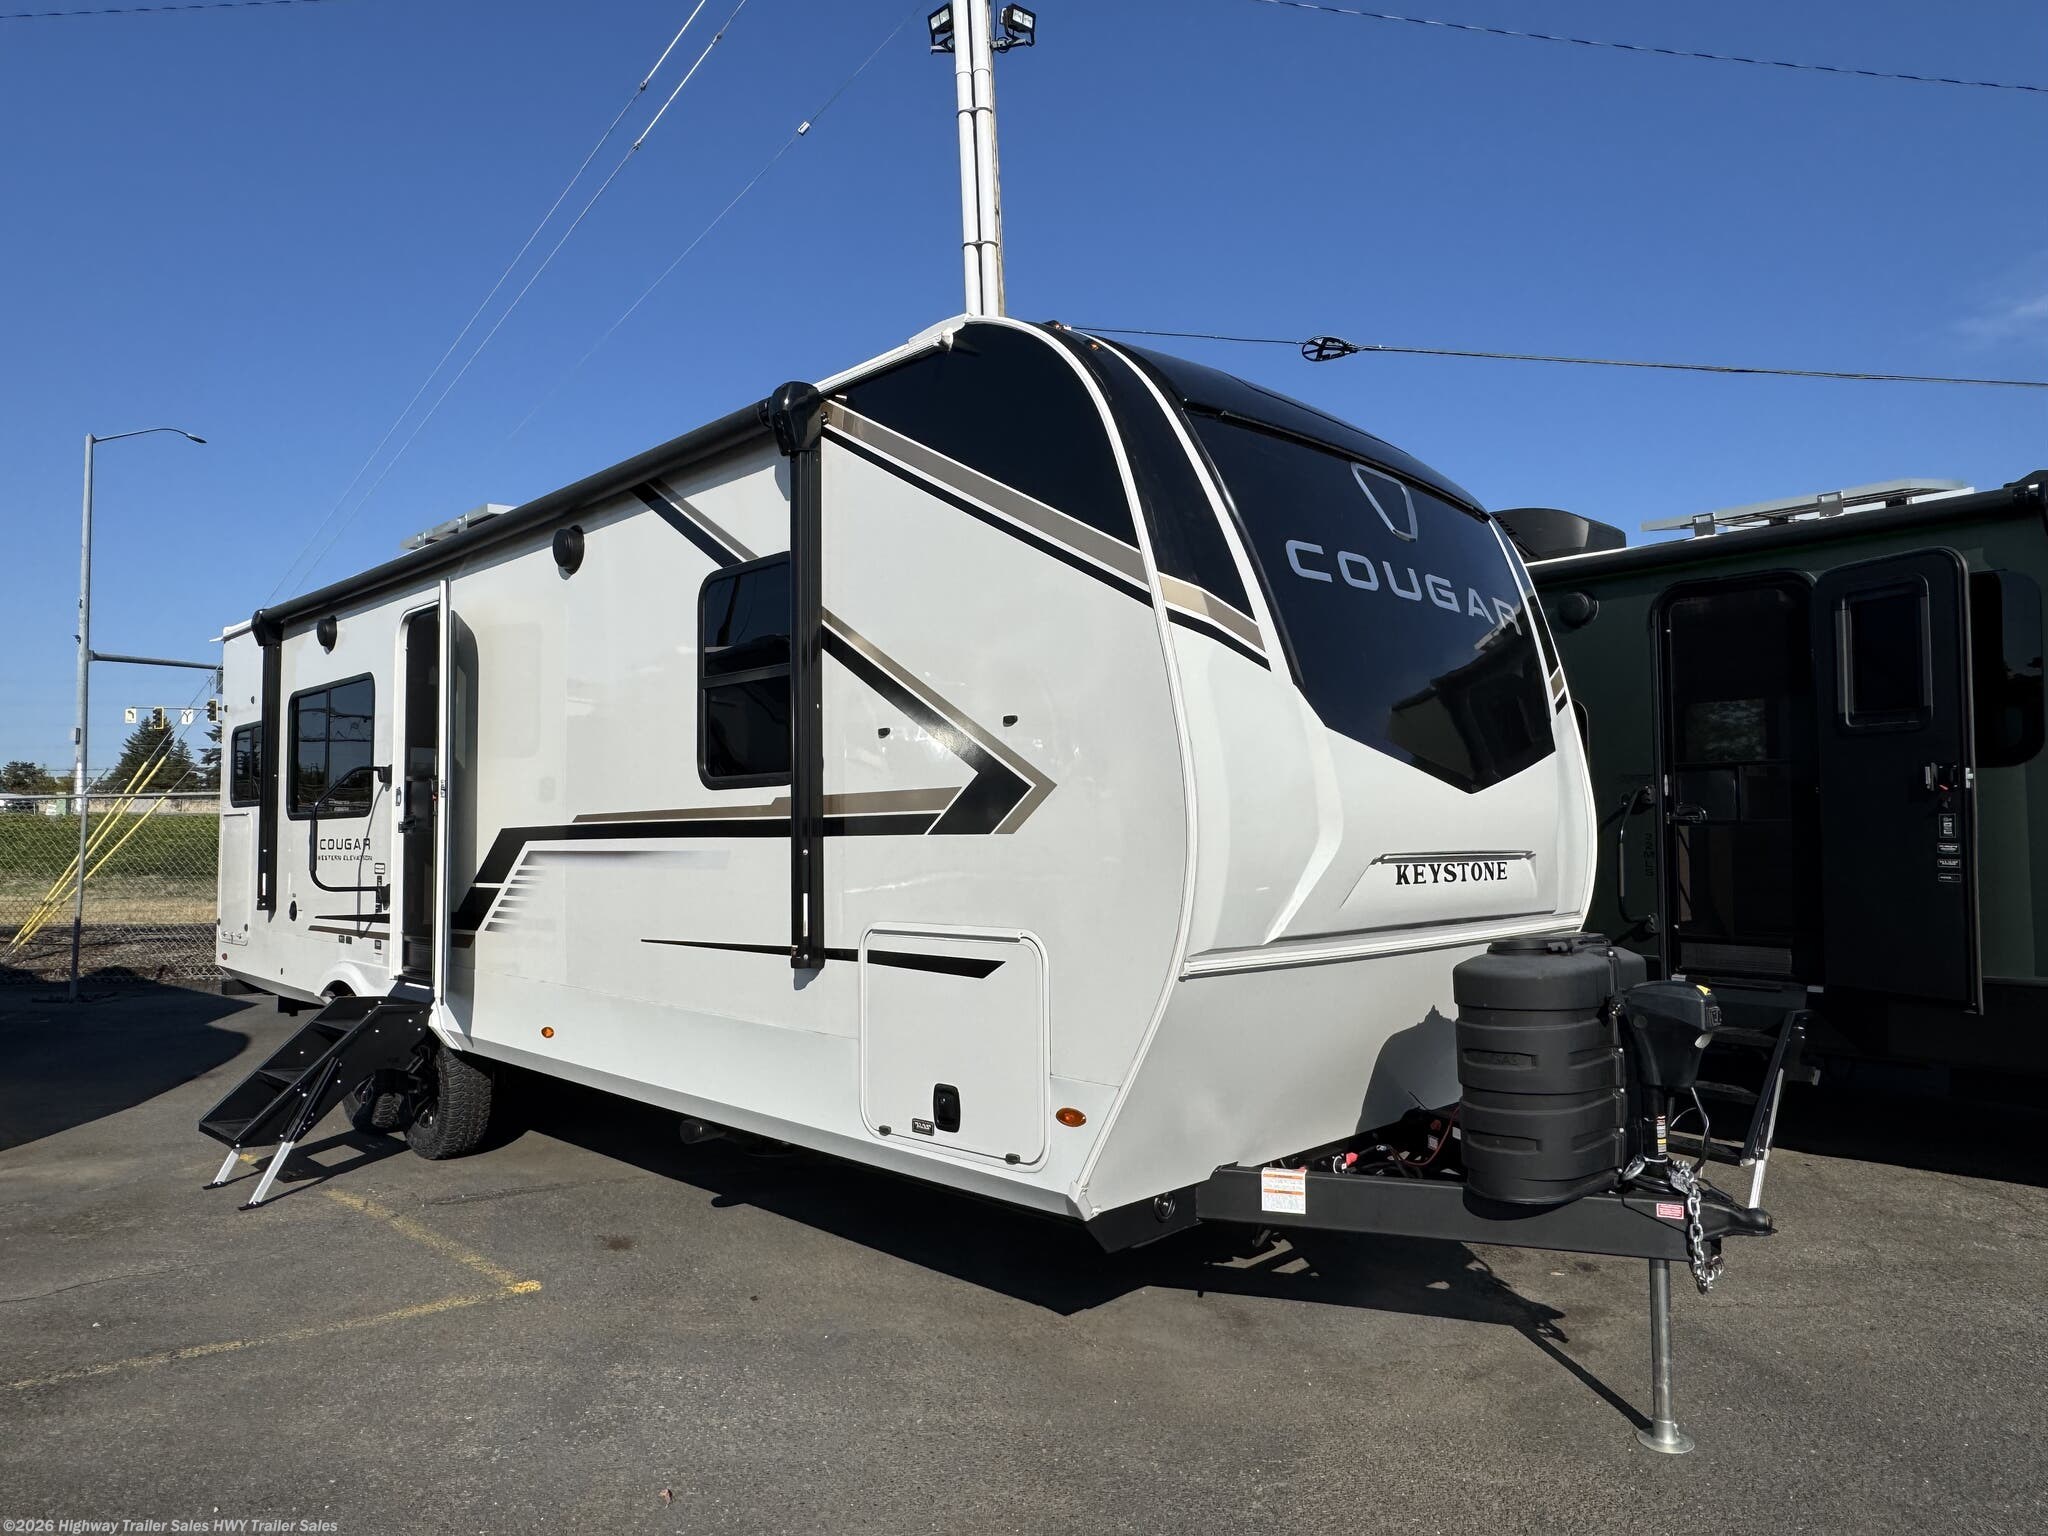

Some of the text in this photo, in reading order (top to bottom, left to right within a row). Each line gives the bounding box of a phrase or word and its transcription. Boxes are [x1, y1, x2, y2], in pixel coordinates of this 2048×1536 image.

[1285, 539, 1522, 636] COUGAR
[320, 838, 371, 850] COUGAR
[1395, 861, 1508, 886] KEYSTONE
